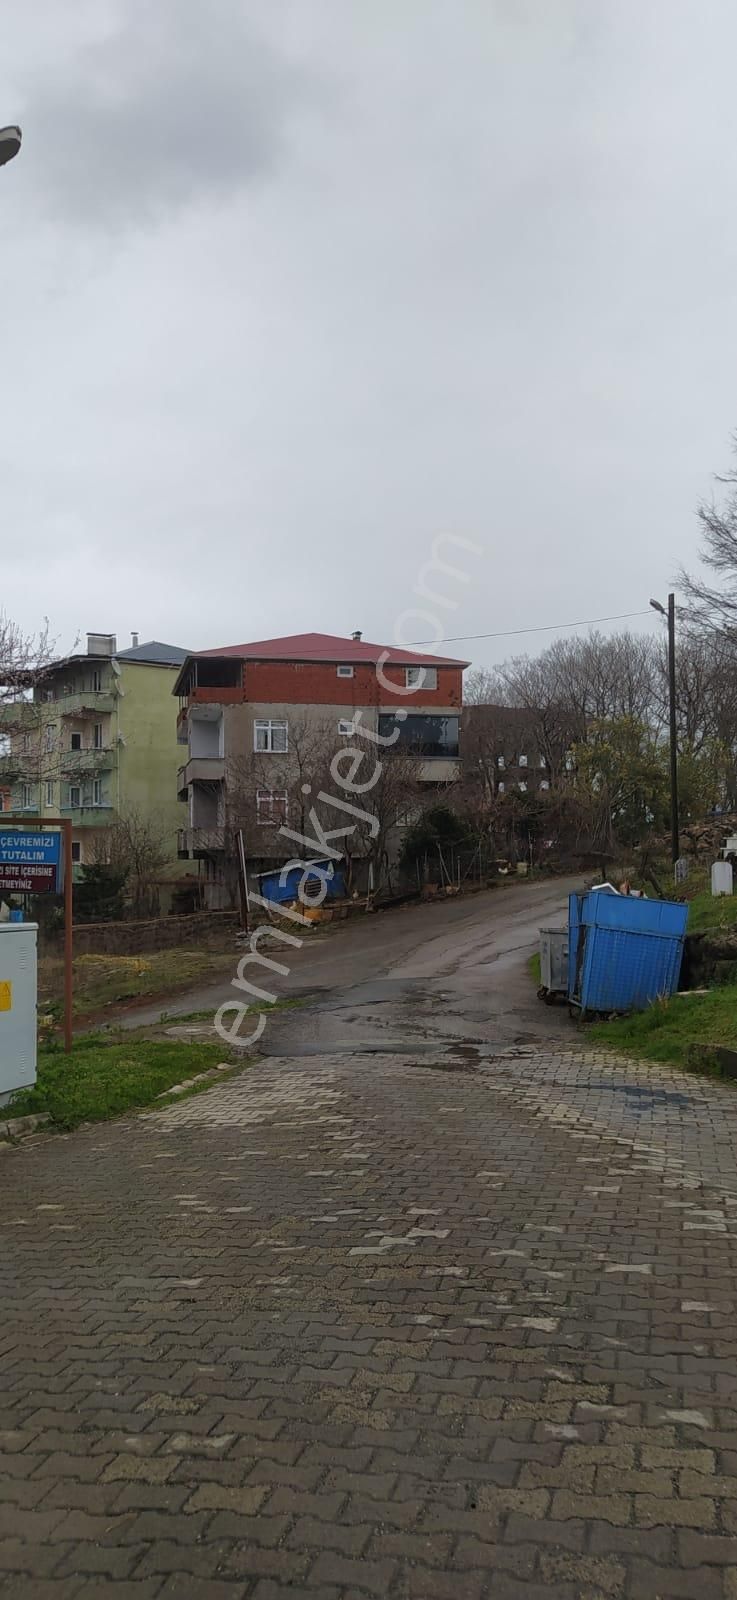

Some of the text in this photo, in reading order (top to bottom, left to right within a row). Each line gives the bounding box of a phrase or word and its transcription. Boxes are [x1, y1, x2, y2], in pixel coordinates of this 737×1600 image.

[0, 837, 54, 848] ÇEVREMİZİ
[1, 850, 45, 860] TUTALIM
[5, 865, 20, 876] SİTE
